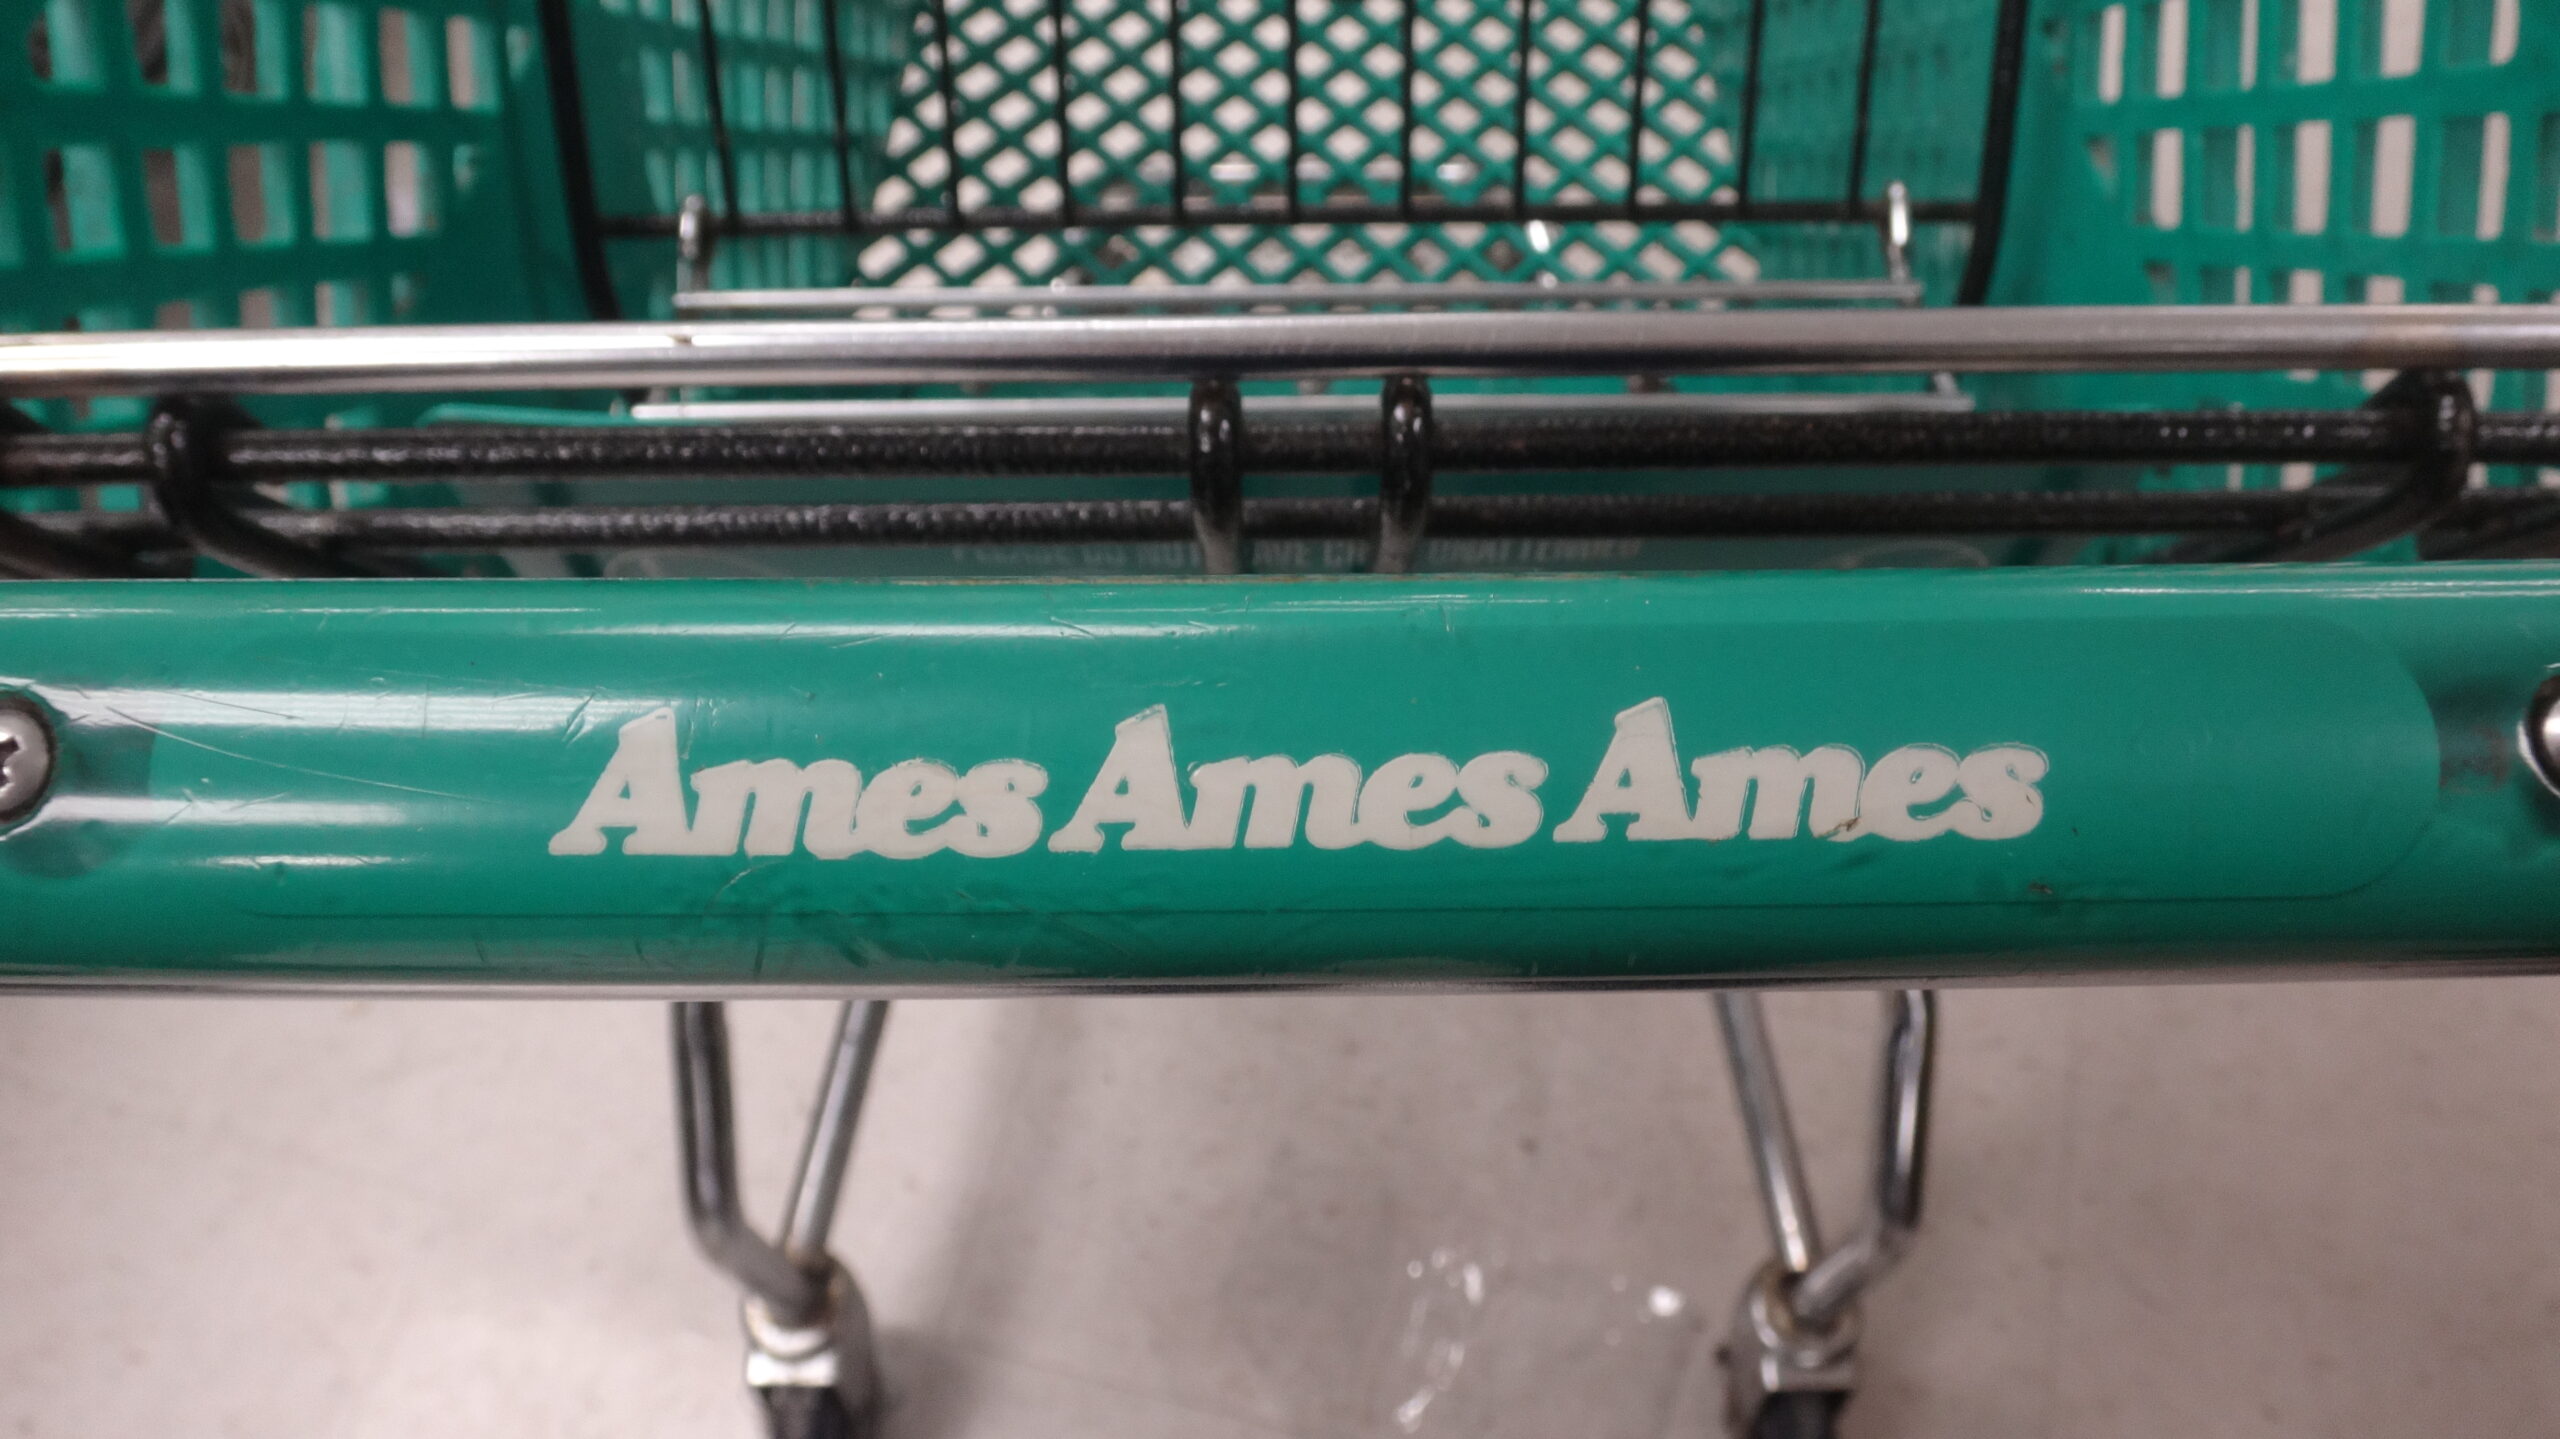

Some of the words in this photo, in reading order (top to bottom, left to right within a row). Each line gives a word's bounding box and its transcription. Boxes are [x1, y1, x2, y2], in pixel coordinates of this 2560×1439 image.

[548, 706, 1048, 860] Ames
[1048, 703, 1548, 853] Ames
[1554, 697, 2049, 842] Ames
